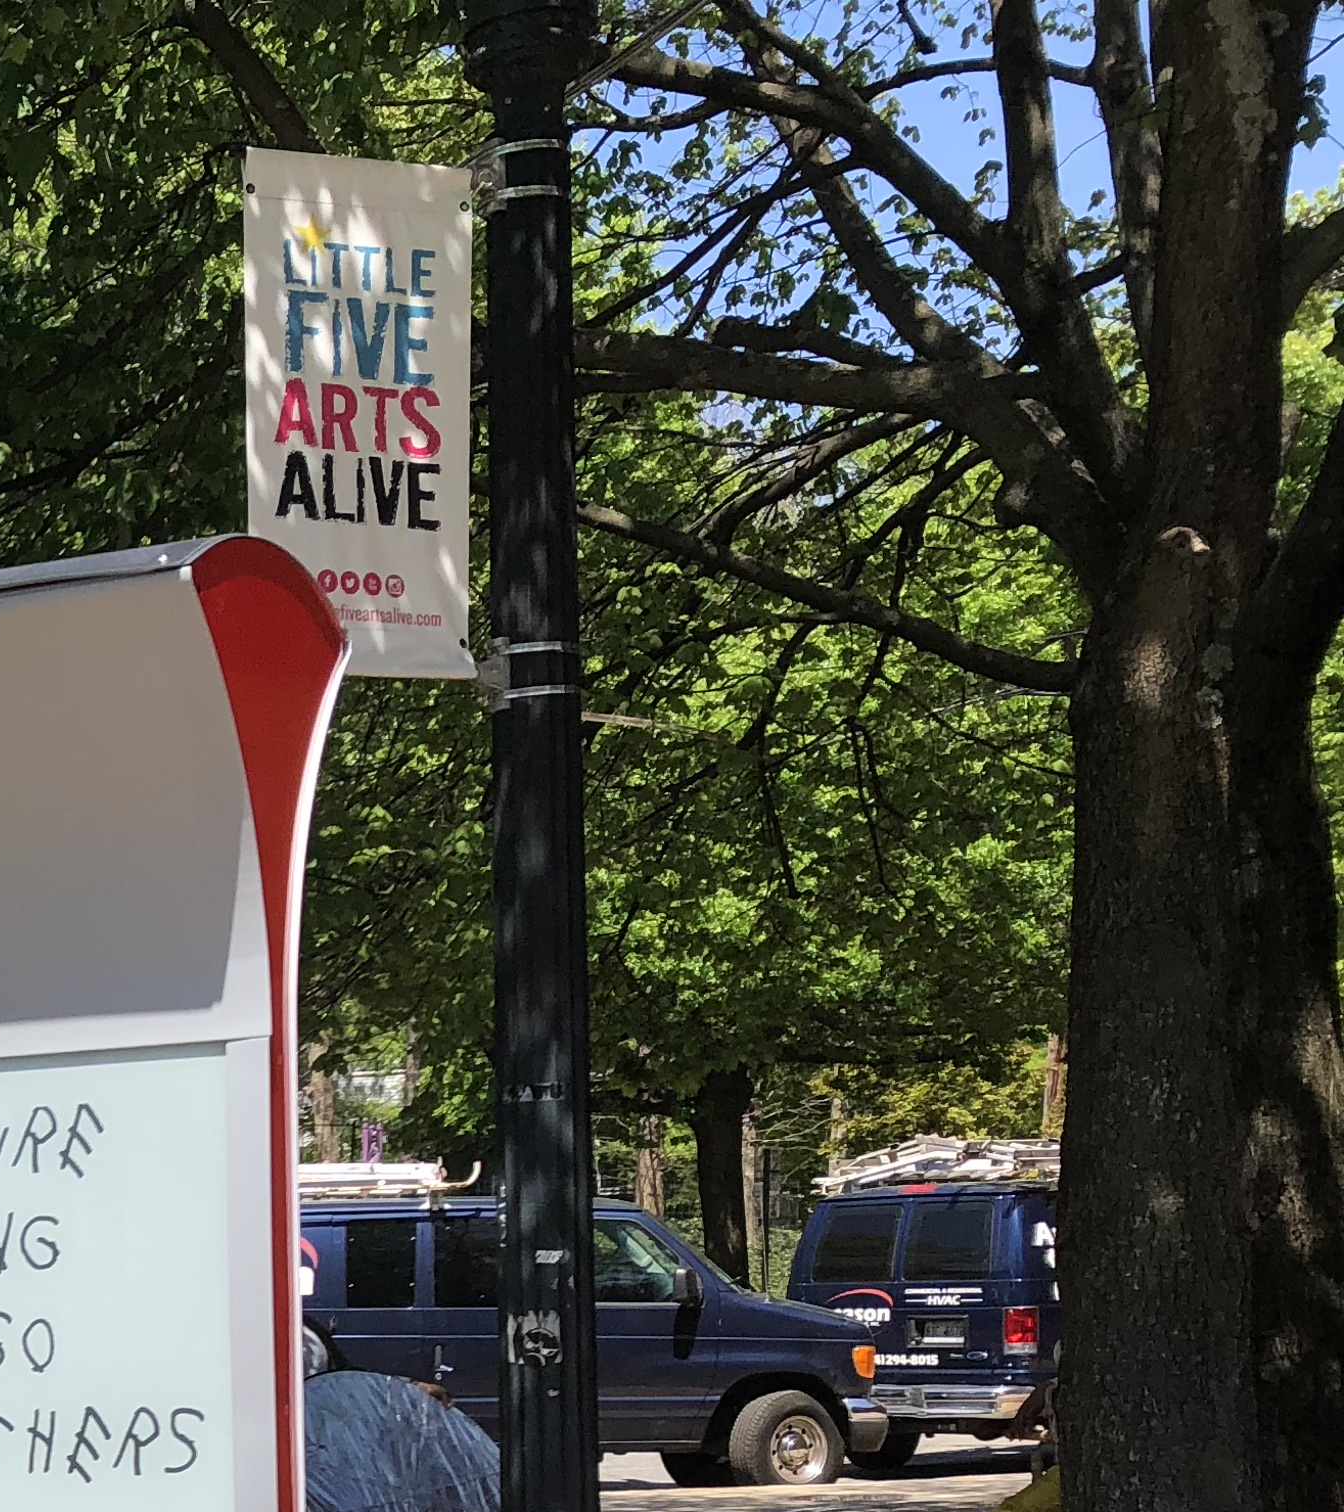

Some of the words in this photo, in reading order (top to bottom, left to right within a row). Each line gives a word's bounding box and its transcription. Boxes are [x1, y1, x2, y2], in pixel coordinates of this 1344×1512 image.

[283, 238, 436, 298] LITTLE
[285, 289, 436, 386] FIVE
[273, 377, 442, 459] ARTS
[274, 450, 442, 532] ALIVE
[927, 1294, 962, 1306] HVAC
